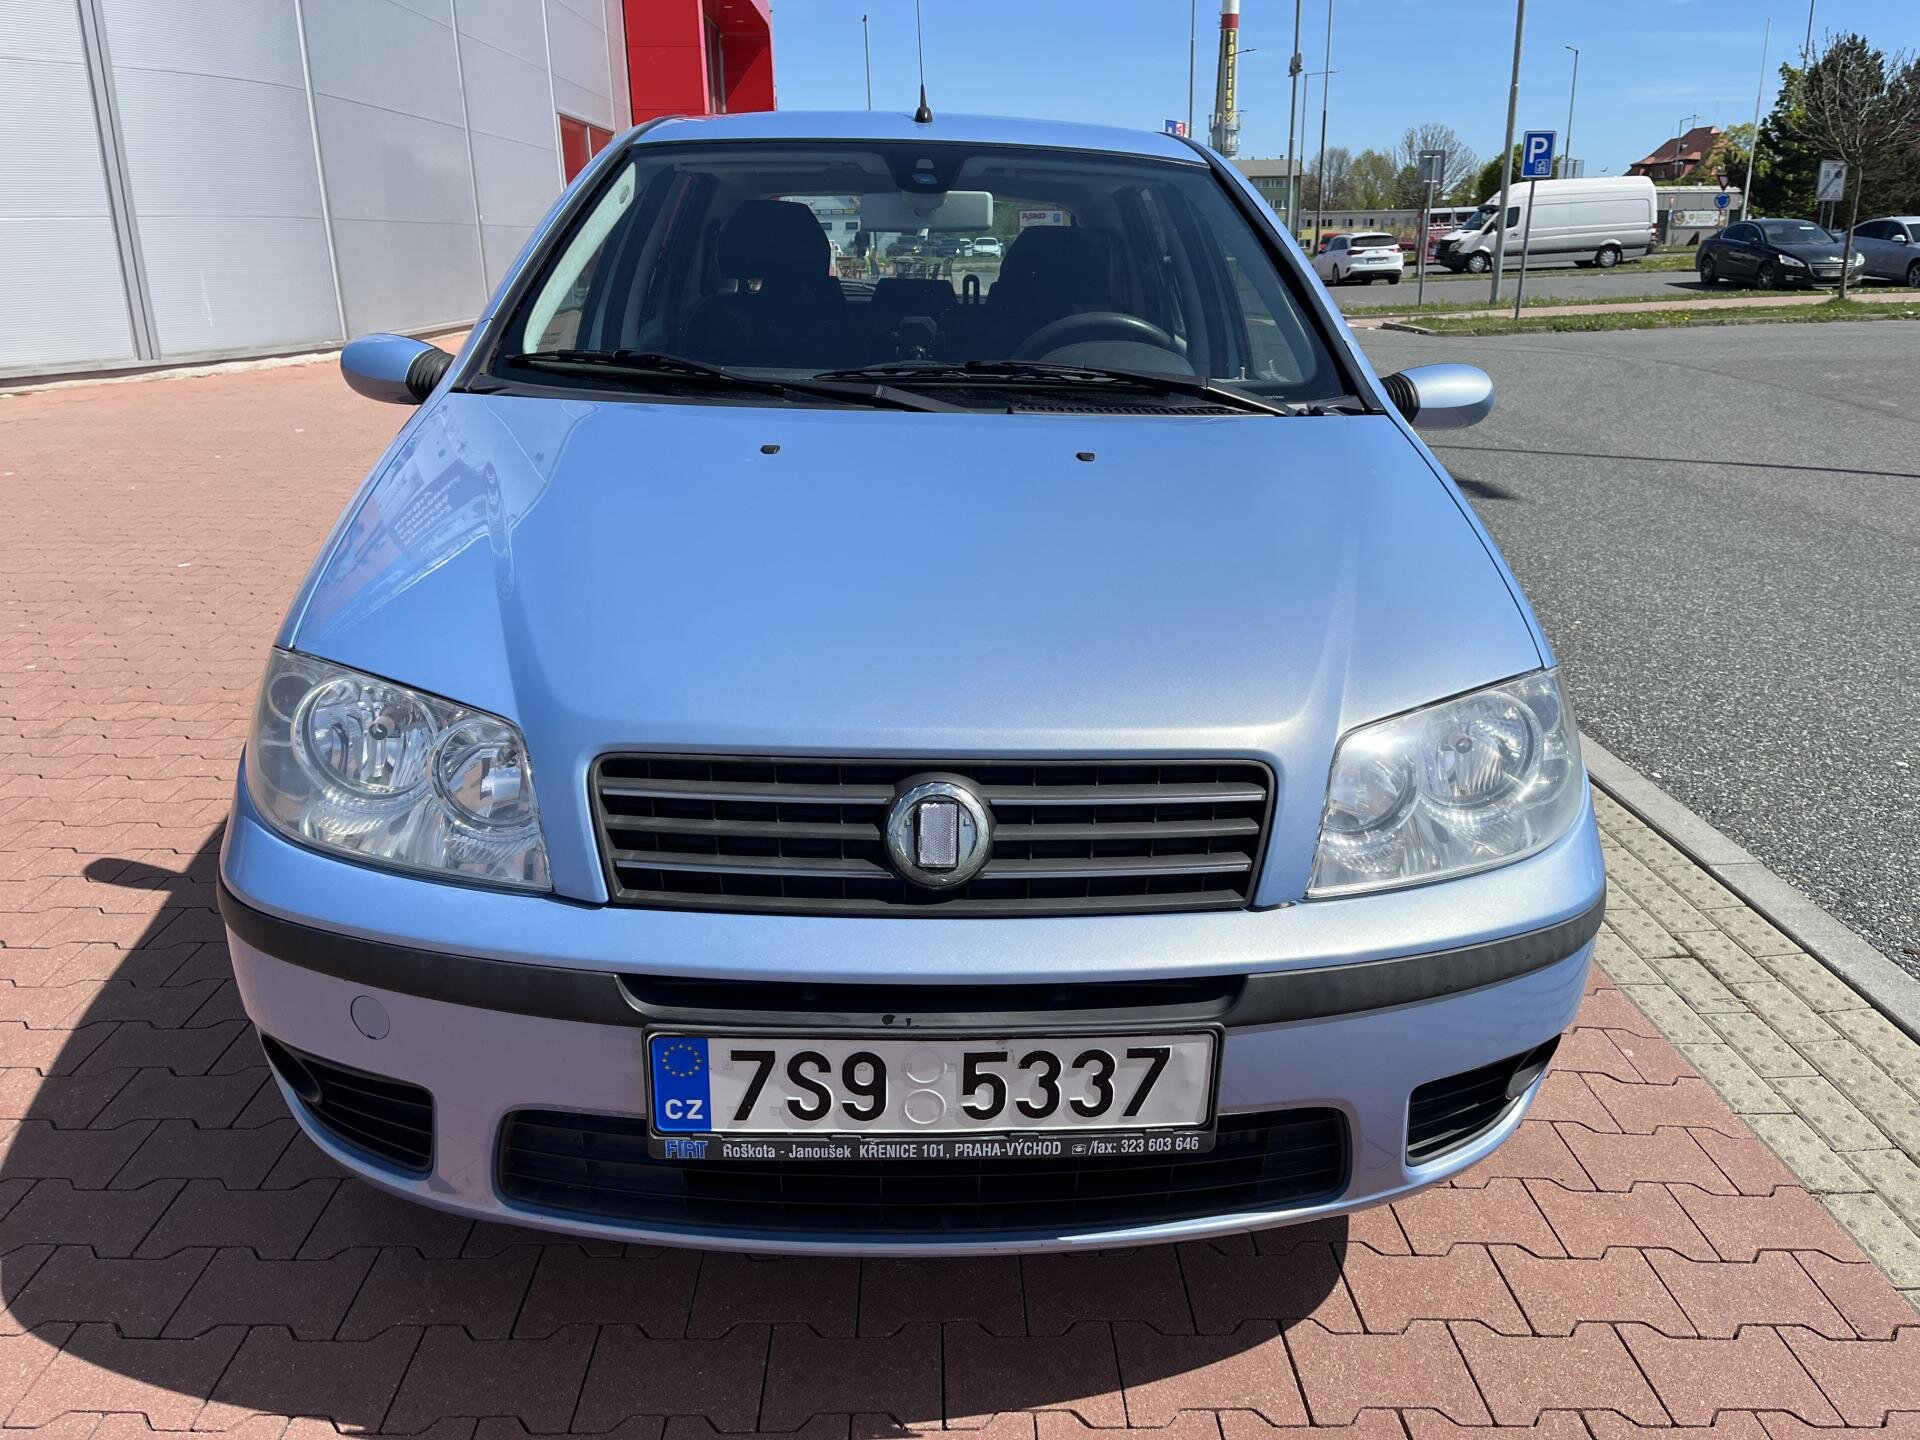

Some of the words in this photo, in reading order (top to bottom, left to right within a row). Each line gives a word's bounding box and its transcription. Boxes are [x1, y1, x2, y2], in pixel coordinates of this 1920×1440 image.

[1529, 137, 1549, 164] P
[731, 1050, 887, 1121] 7S9
[963, 1047, 1171, 1120] 5337
[665, 1099, 704, 1120] CZ
[665, 1140, 708, 1159] FIAT
[723, 1143, 776, 1158] Roškota
[789, 1143, 851, 1159] Janoušek
[860, 1140, 917, 1158] KŘENICE
[922, 1144, 950, 1160] 101,
[955, 1139, 1062, 1157] PRAHA-VÝCHOD
[1121, 1139, 1144, 1153] 323
[1149, 1138, 1171, 1152] 603
[1175, 1136, 1199, 1151] 646
